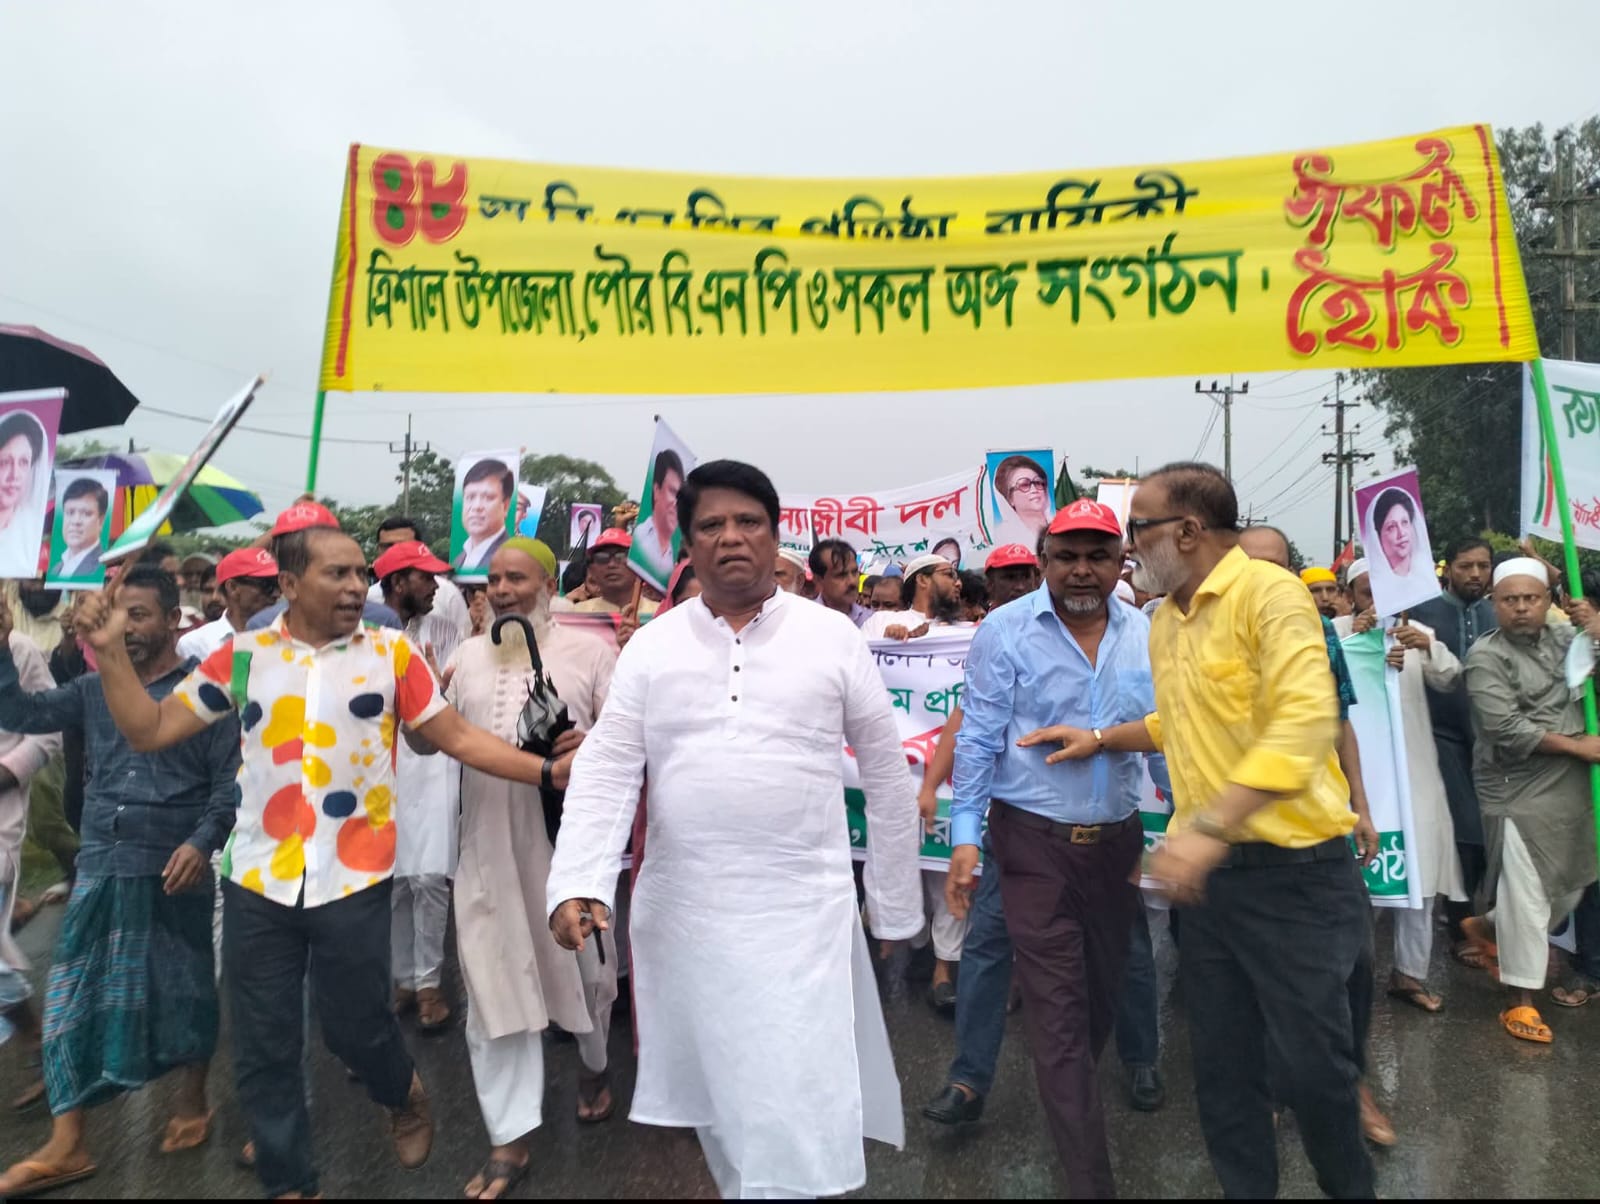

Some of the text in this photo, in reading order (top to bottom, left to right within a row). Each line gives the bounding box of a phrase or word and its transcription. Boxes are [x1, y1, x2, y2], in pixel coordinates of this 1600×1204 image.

[1284, 137, 1480, 250] সফল
[367, 248, 449, 332] ত্রিশাল
[945, 261, 1027, 328] অঙ্গ
[1284, 242, 1471, 355] হোক
[894, 486, 969, 527] দল
